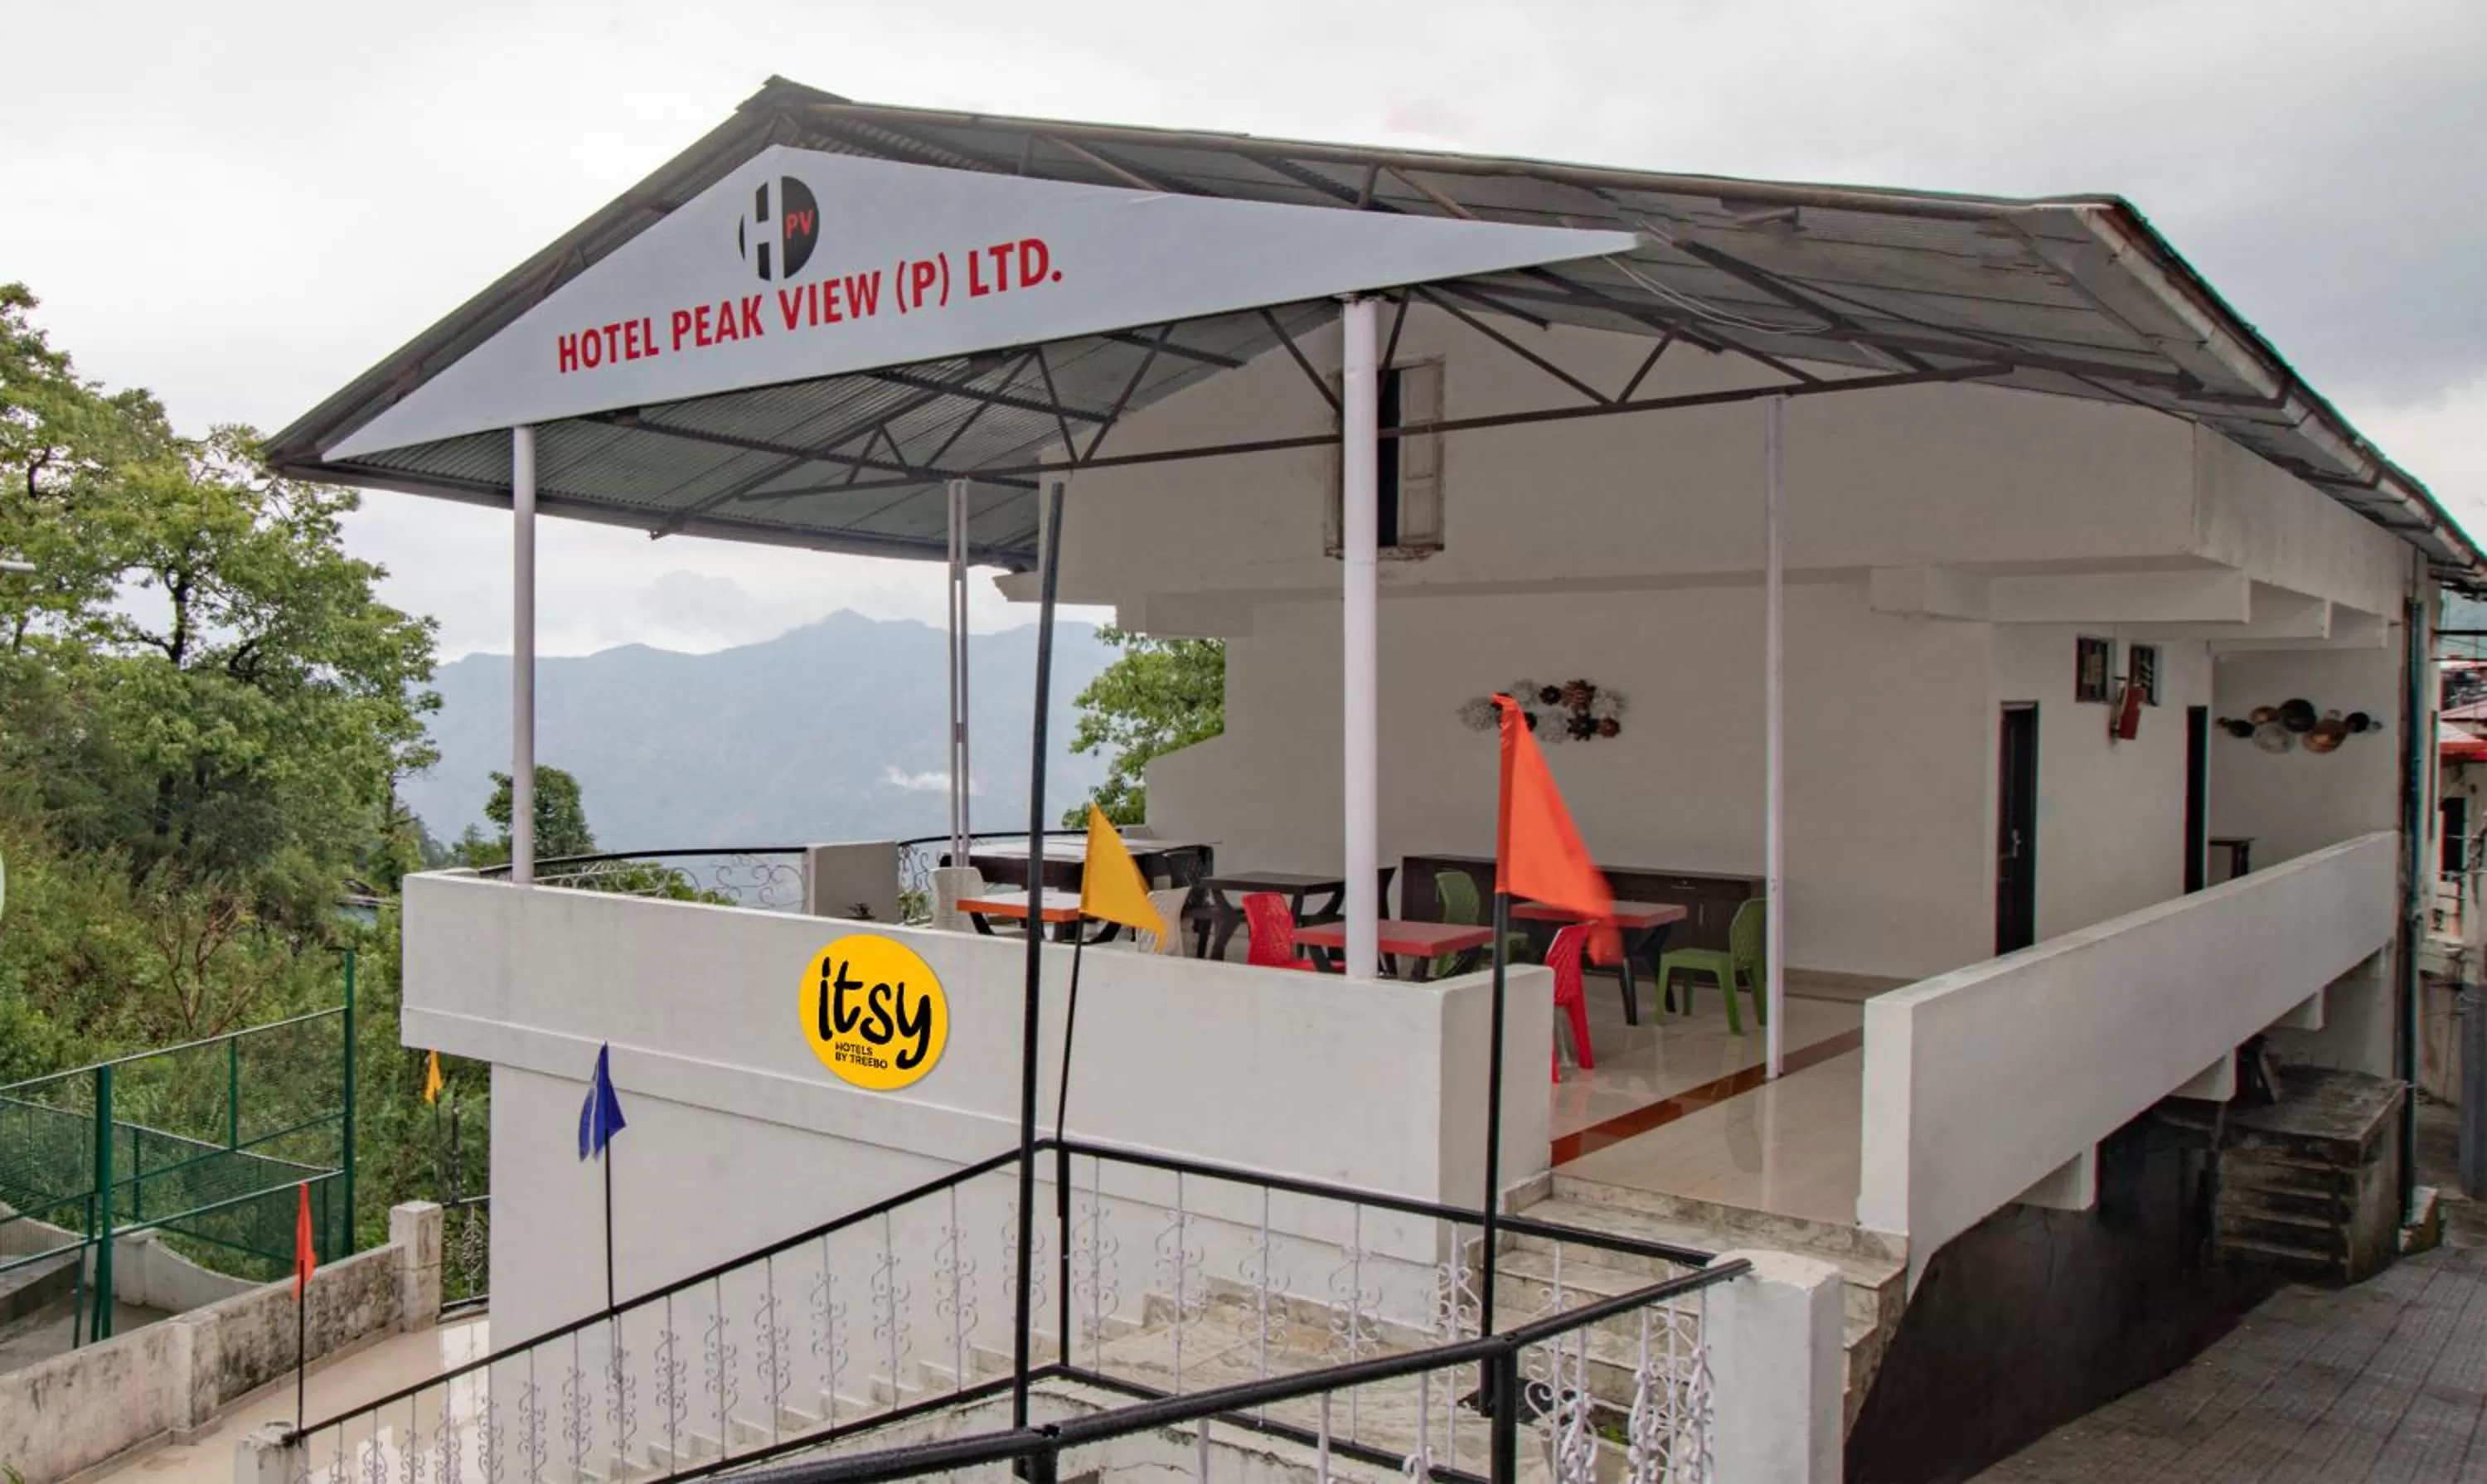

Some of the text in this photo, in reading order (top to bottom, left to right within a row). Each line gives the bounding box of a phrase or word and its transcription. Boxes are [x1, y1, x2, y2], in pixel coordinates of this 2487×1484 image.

[785, 210, 813, 240] PV
[558, 237, 1063, 374] HOTEL PEAK VIEW (P) LTD.
[818, 956, 932, 1069] itsy
[835, 1041, 873, 1056] HOTELS
[835, 1052, 888, 1069] BY TREEBO
